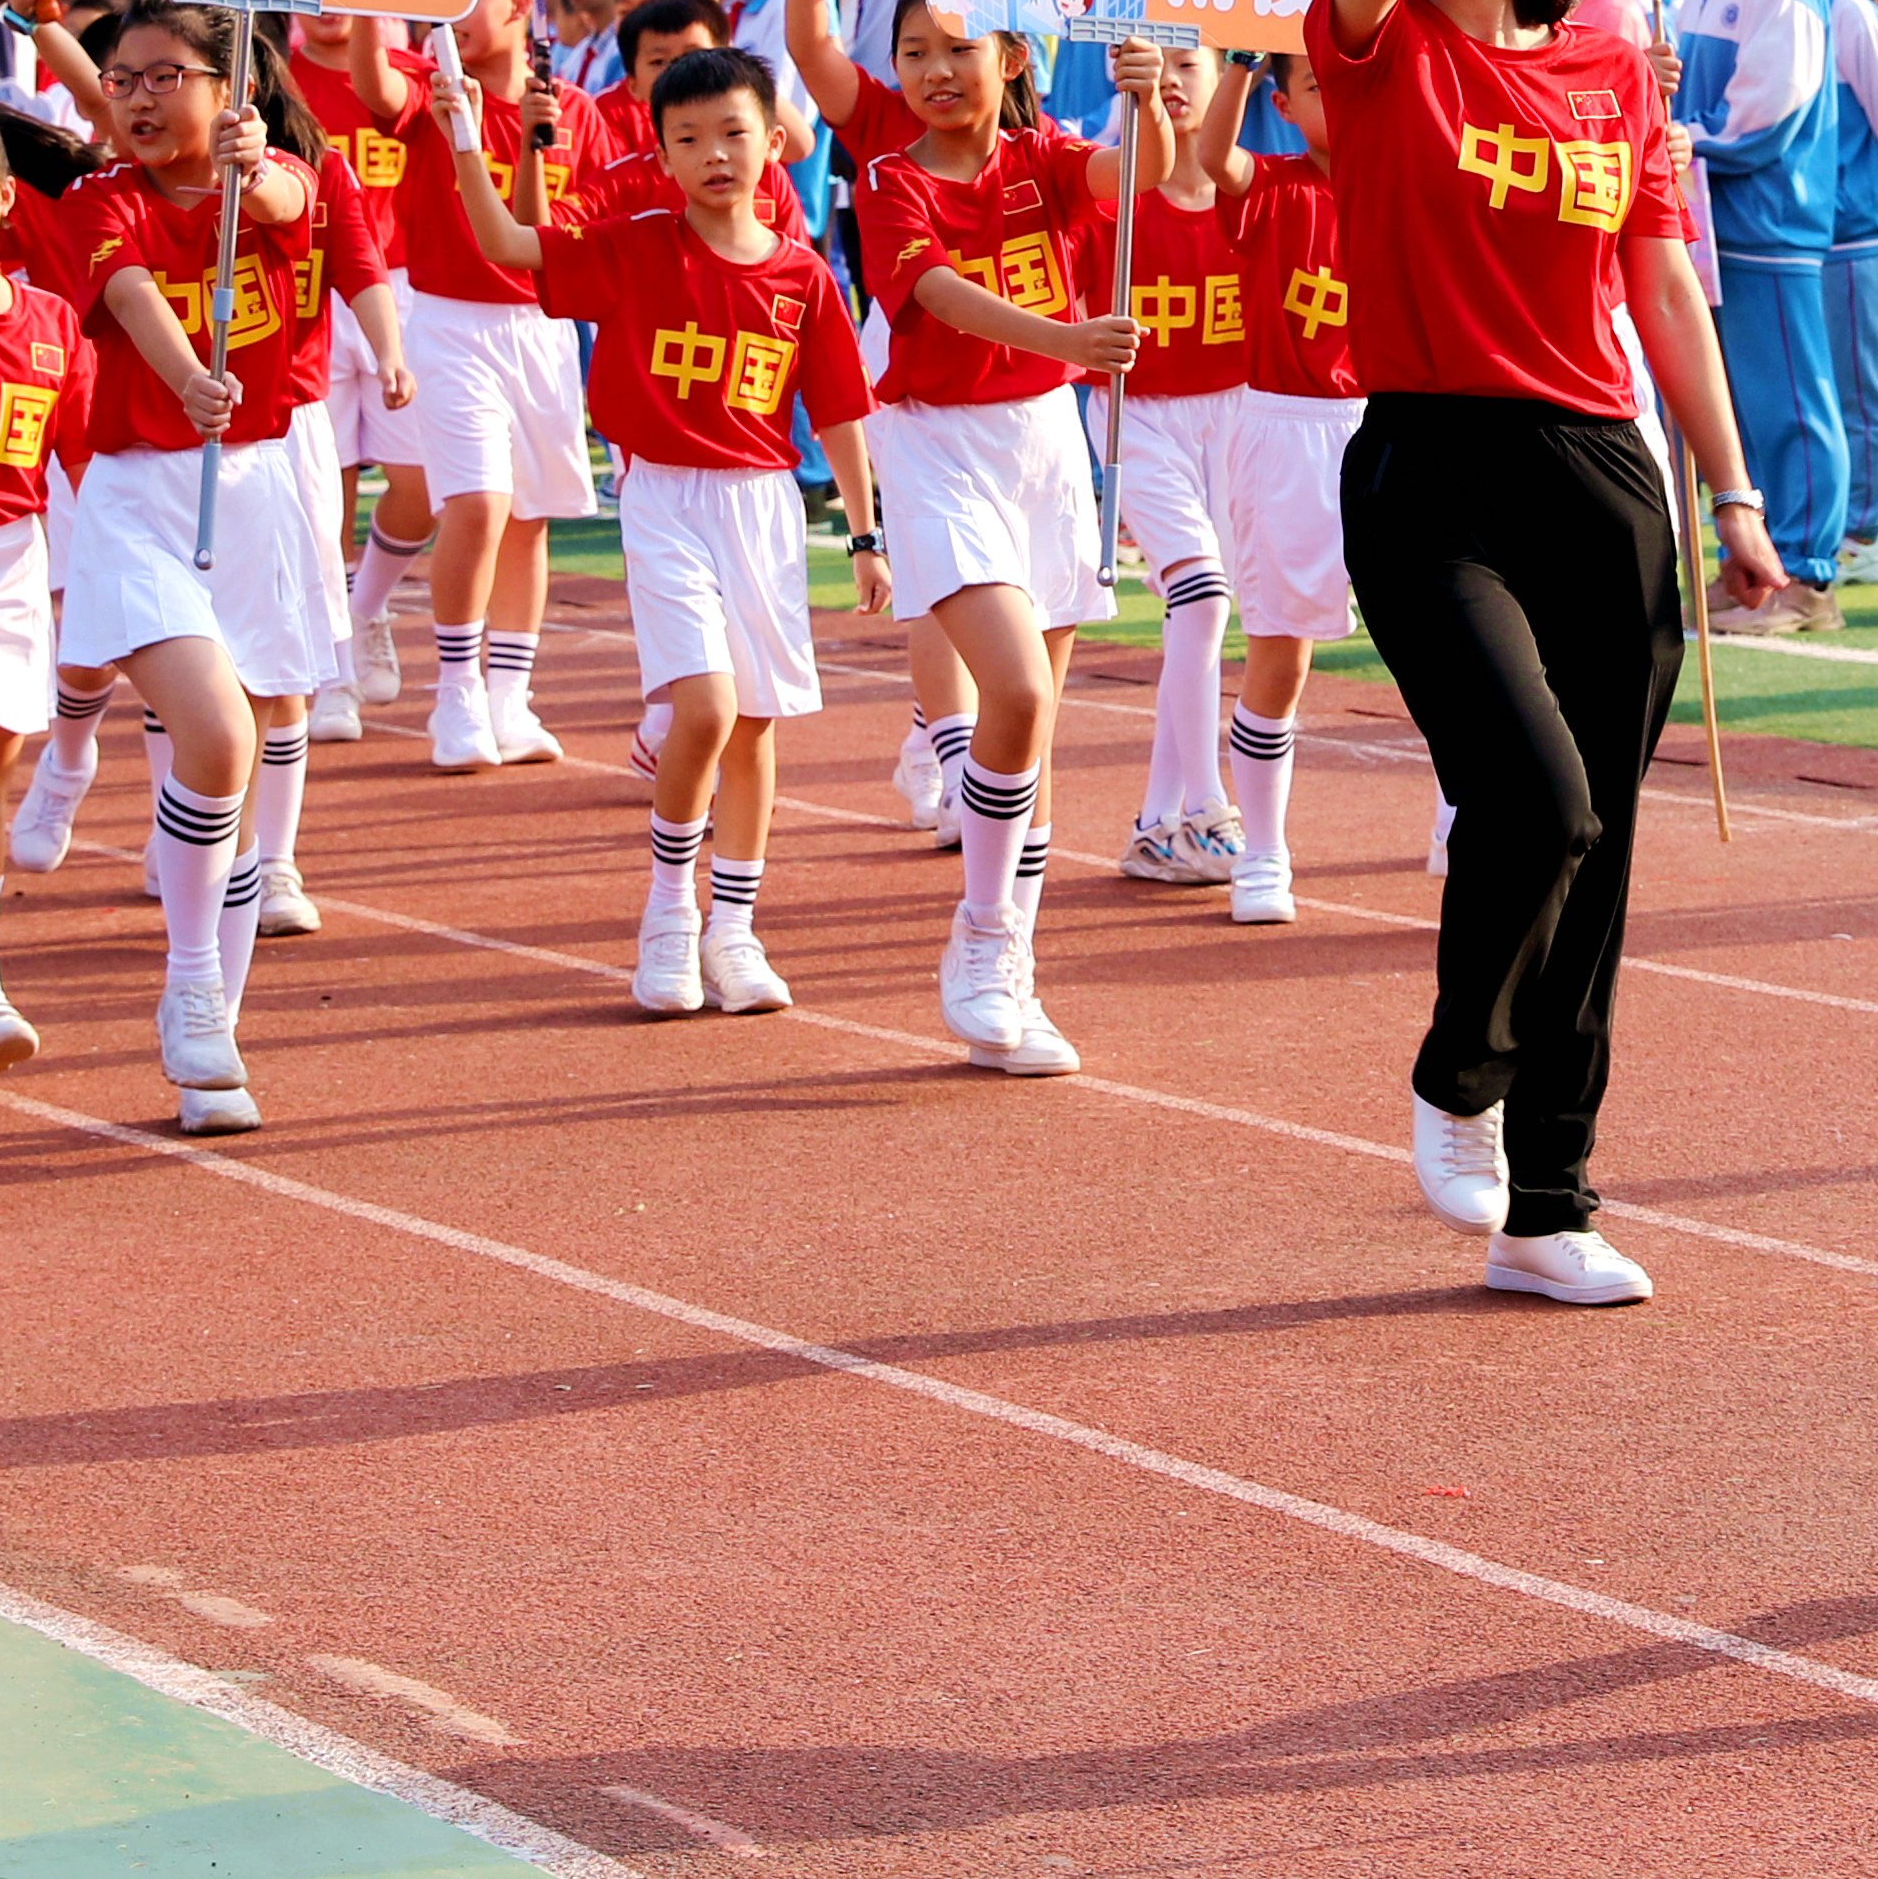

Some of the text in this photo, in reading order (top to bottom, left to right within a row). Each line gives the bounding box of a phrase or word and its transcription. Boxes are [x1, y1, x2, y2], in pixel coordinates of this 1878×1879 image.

[1458, 123, 1632, 234] 中国
[1130, 274, 1246, 347] 中国
[650, 321, 796, 415] 中国
